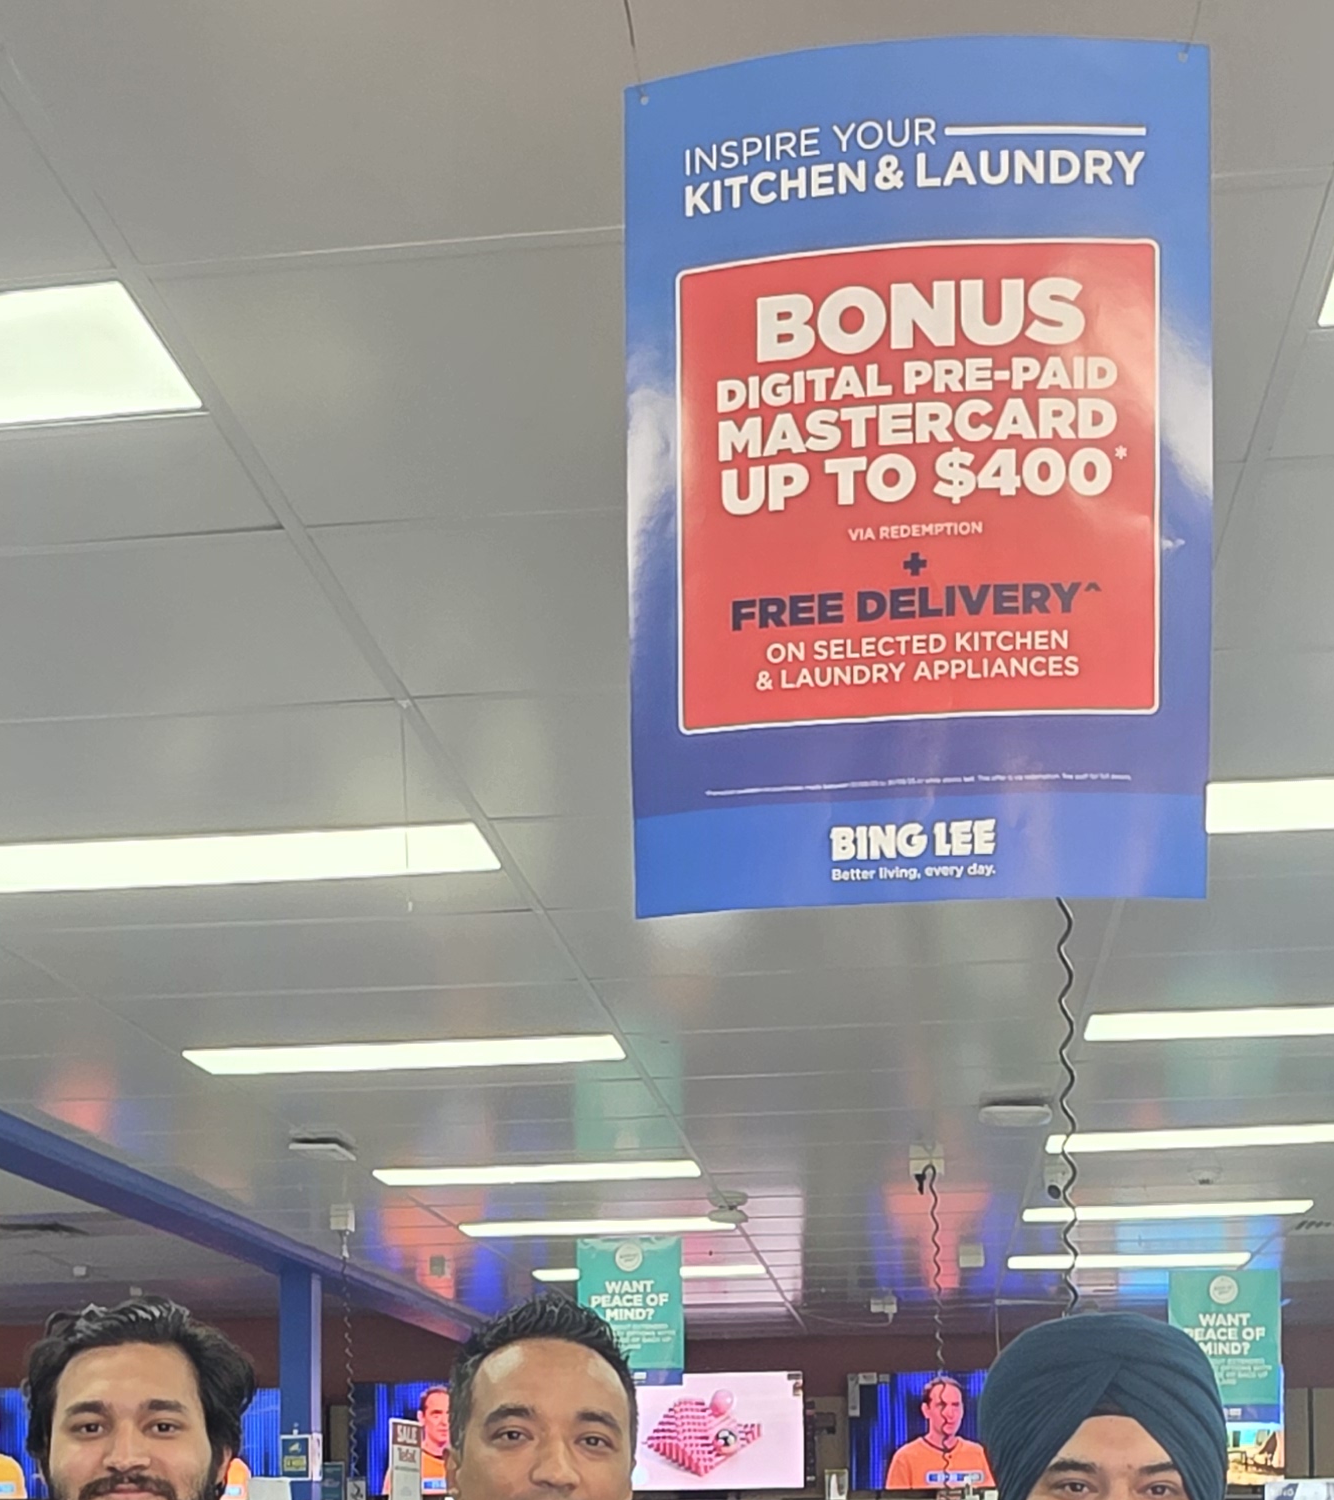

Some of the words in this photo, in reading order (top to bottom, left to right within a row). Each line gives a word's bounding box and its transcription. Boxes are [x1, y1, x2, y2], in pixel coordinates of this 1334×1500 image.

[685, 126, 821, 176] INSPIRE
[833, 117, 937, 152] YOUR
[684, 159, 866, 217] KITCHEN
[874, 154, 904, 190] &
[916, 150, 1146, 188] LAUNDRY
[756, 277, 1085, 363] BONUS
[717, 364, 893, 412] DIGITAL
[904, 357, 1118, 395] PRE-PAID
[717, 398, 1118, 462] MASTERCARD
[721, 463, 809, 515] UP
[825, 453, 916, 506] TO
[848, 527, 875, 541] VIA
[879, 521, 983, 540] REDEMPTION
[731, 592, 844, 632] FREE
[767, 641, 805, 663] ON
[813, 633, 946, 660] SELECTED
[954, 629, 1068, 652] KITCHEN
[756, 670, 773, 690] &
[780, 660, 906, 689] LAUNDRY
[913, 655, 1079, 681] APPLIANCES
[830, 823, 927, 861] BING
[933, 818, 996, 856] LEE
[831, 867, 875, 882] Better
[878, 865, 922, 880] living,
[925, 865, 964, 879] every
[967, 861, 996, 877] day.
[590, 1294, 643, 1307] PEACE
[646, 1293, 669, 1306] OF
[605, 1280, 655, 1293] WANT
[605, 1308, 655, 1321] MIND?
[1199, 1313, 1251, 1327] WANT
[1185, 1327, 1238, 1340] PEACE
[1242, 1327, 1266, 1340] OF
[1199, 1341, 1251, 1355] MIND?
[397, 1425, 417, 1444] SALE
